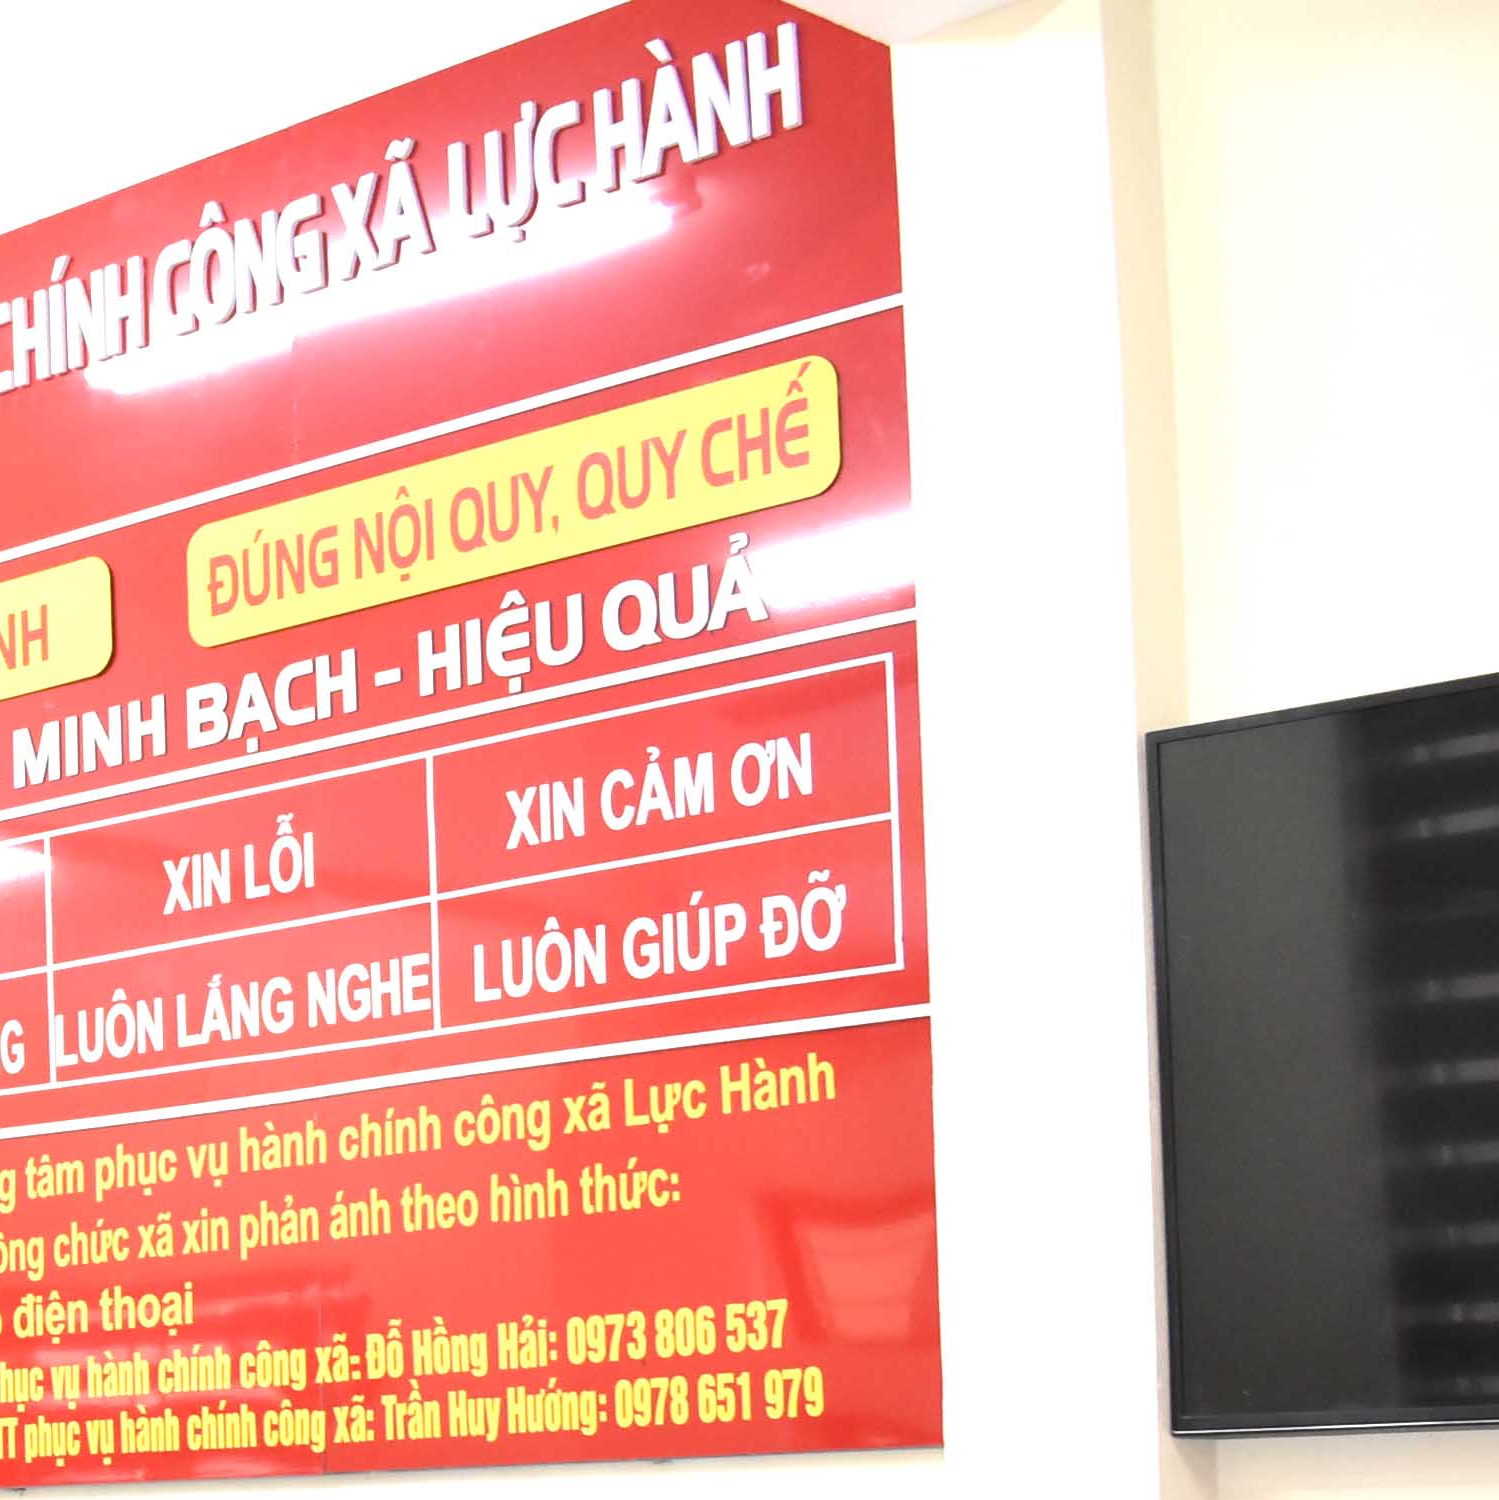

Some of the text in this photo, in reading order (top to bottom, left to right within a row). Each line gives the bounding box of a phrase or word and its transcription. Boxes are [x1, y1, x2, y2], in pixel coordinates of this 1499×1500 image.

[153, 192, 331, 339] CÔNG
[329, 136, 435, 284] XÃ
[446, 98, 587, 242] LỰC
[592, 20, 805, 193] HÀNH
[205, 359, 813, 618] ĐÚNG NỘI QUY, QUY CHẾ
[12, 694, 166, 789] MINH
[186, 648, 357, 754] BẠCH
[417, 589, 583, 697] HIỆU
[602, 531, 770, 652] QUẢ
[504, 731, 814, 851] XIN CẢM ƠN
[161, 811, 316, 916] XIN LỖI
[472, 868, 848, 1004] LUÔN GIÚP ĐỠ
[52, 951, 433, 1069] LUÔN LẮNG NGHE
[23, 1152, 86, 1201] tâm
[93, 1142, 179, 1204] phục
[185, 1139, 230, 1189] vụ
[237, 1118, 329, 1174] hành
[337, 1103, 443, 1162] chính
[452, 1092, 552, 1153] công
[561, 1080, 612, 1136] xã
[622, 1077, 708, 1135] Lực
[718, 1051, 837, 1116] Hành
[12, 1288, 90, 1346] điện
[97, 1280, 195, 1338] thoại
[49, 1362, 83, 1412] vụ
[83, 1348, 153, 1402] hành
[156, 1342, 233, 1396] chính
[238, 1338, 308, 1393] công
[313, 1331, 363, 1385] xã:
[364, 1317, 406, 1381] Đỗ
[410, 1314, 490, 1379] Hồng
[495, 1313, 559, 1372] Hải:
[565, 1309, 648, 1366] 0973
[653, 1304, 718, 1360] 806
[724, 1297, 790, 1354] 537
[23, 1414, 82, 1468] phục
[84, 1417, 116, 1467] vụ
[118, 1401, 181, 1455] hành
[185, 1398, 259, 1452] chính
[262, 1397, 327, 1455] công
[332, 1393, 376, 1445] xã:
[379, 1377, 443, 1442] Trần
[446, 1388, 503, 1444] Huy
[505, 1375, 609, 1437] Hướng:
[613, 1374, 691, 1430] 0978
[696, 1370, 753, 1425] 651
[762, 1364, 826, 1421] 979
